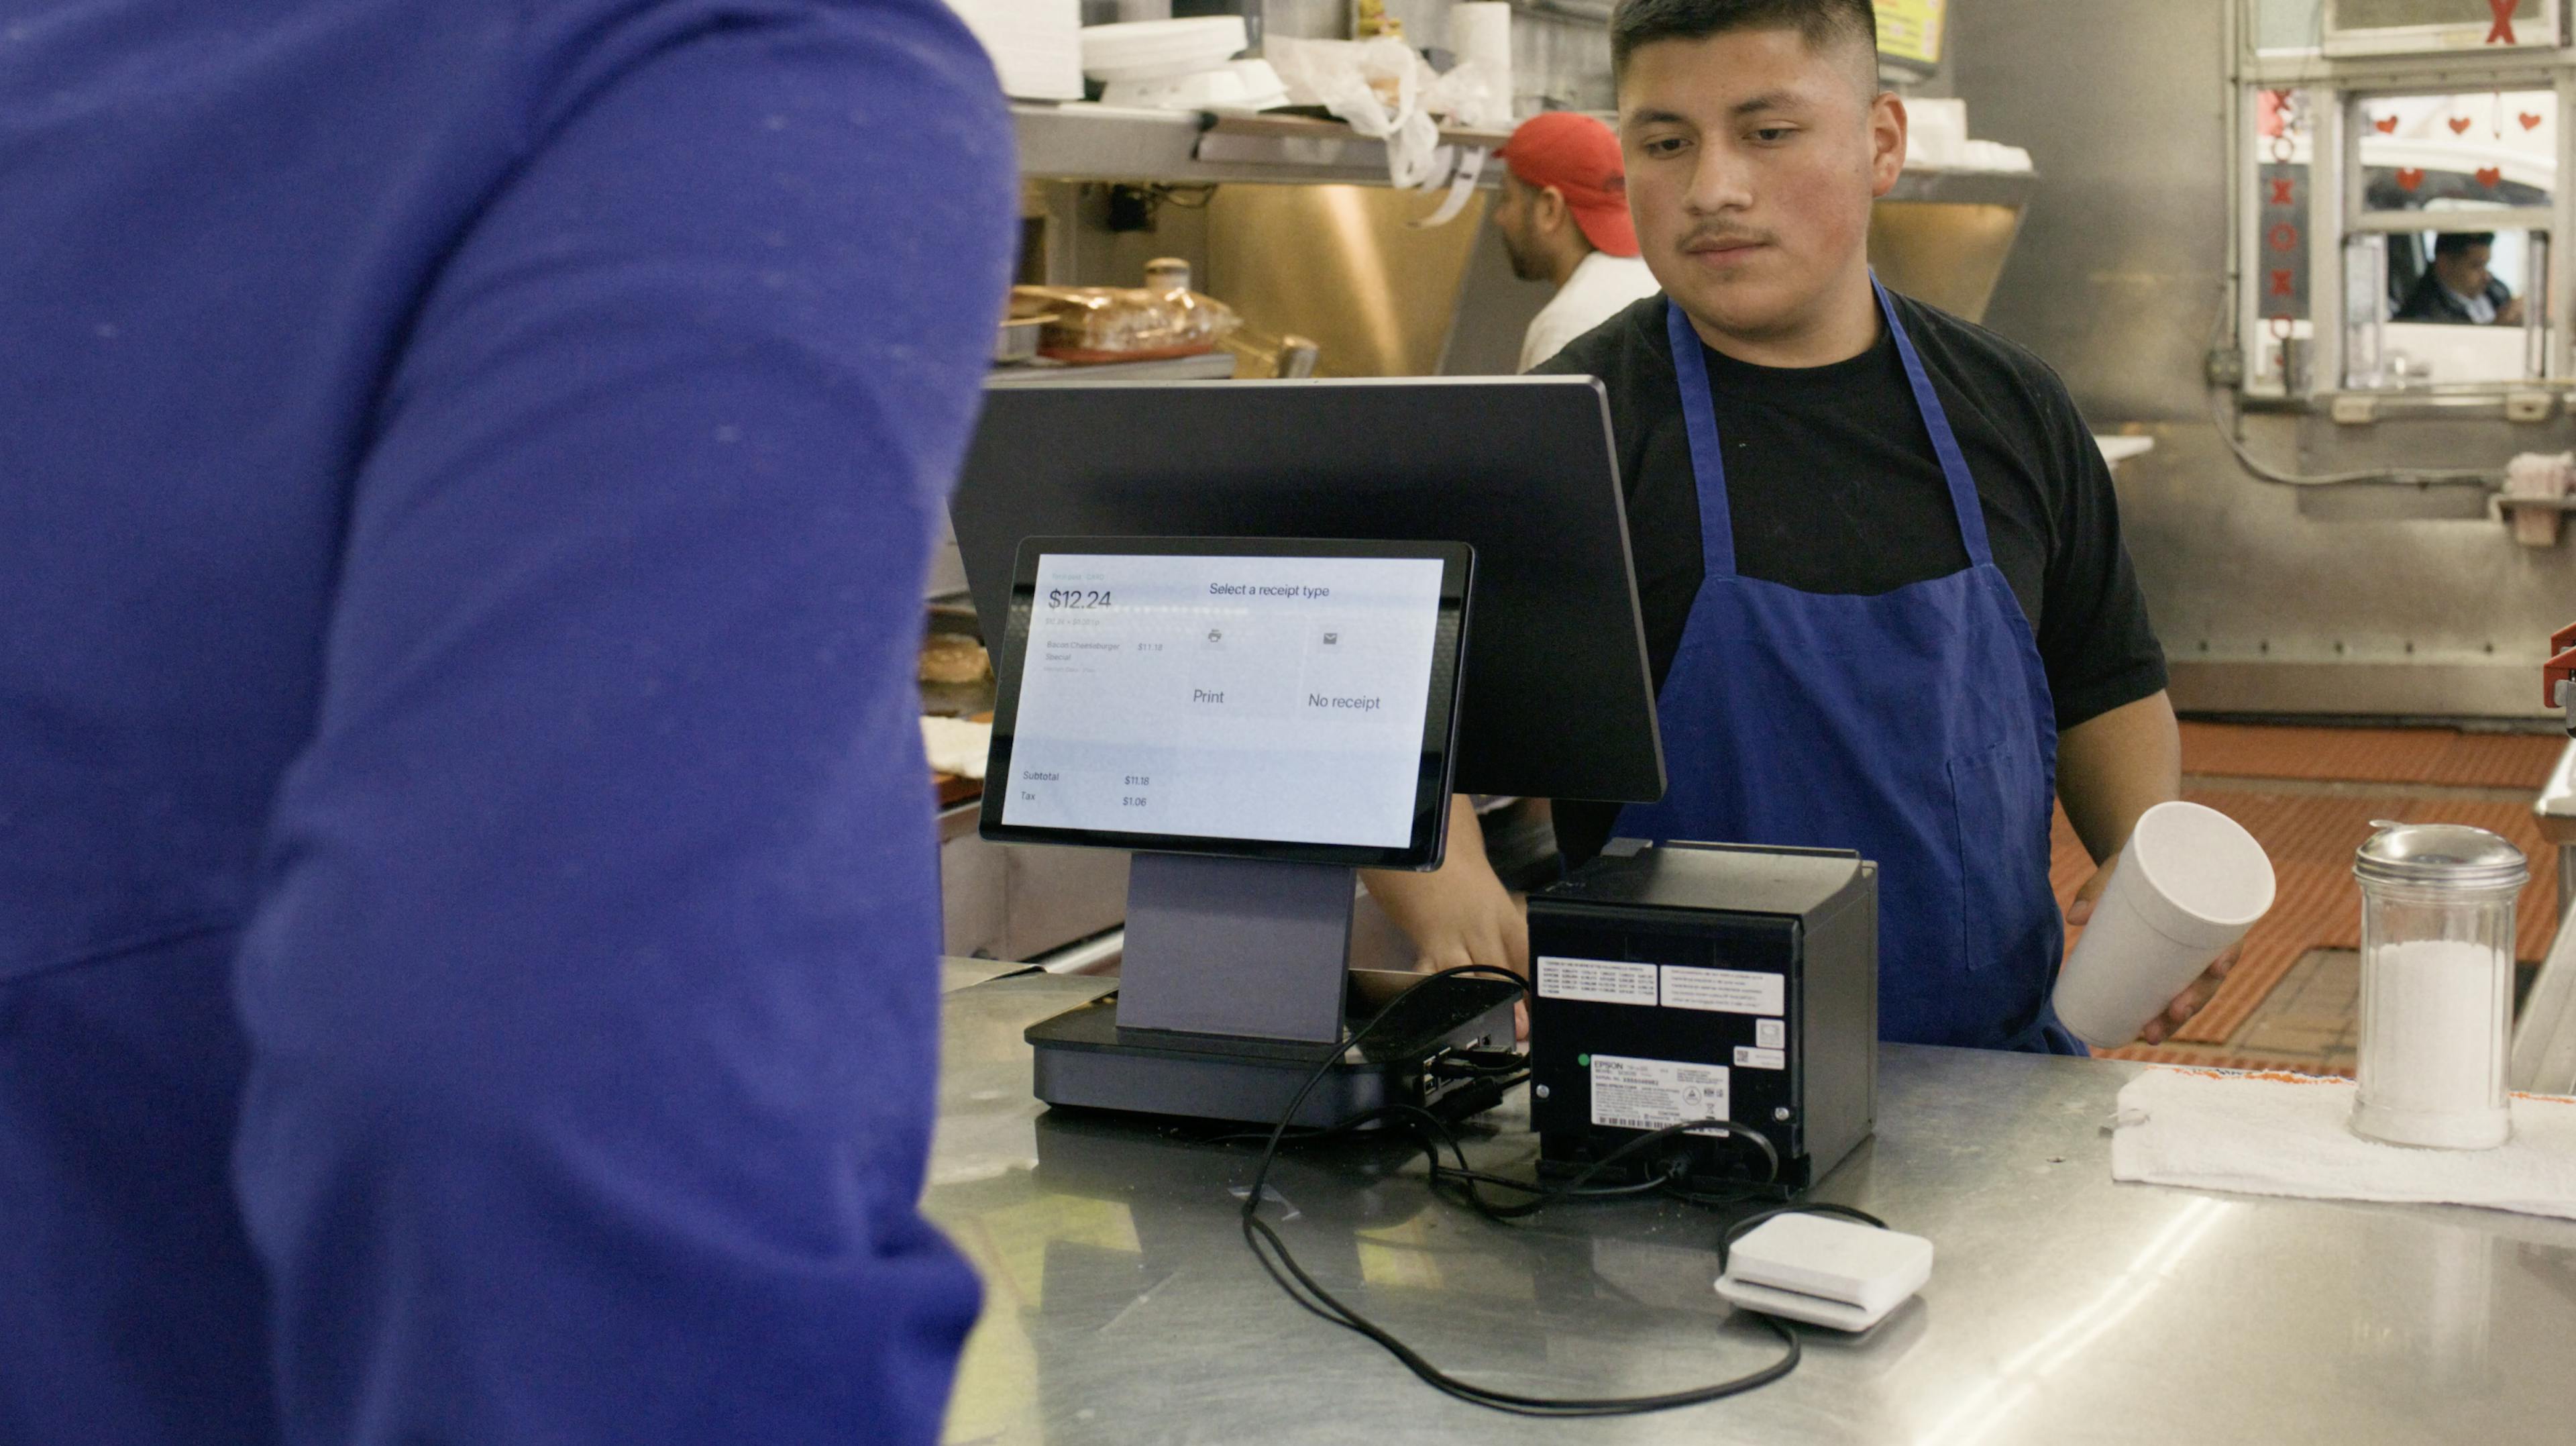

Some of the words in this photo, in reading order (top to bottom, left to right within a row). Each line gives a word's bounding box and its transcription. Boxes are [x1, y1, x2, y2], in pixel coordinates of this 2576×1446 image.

[1209, 582, 1246, 595] Select
[1248, 586, 1256, 595] a
[1259, 584, 1299, 599] receipt
[1303, 585, 1330, 599] type
[1048, 588, 1112, 610] $12.24
[1046, 640, 1069, 649] Bacon
[1070, 641, 1120, 652] Cheeseburger
[1138, 643, 1163, 652] $11.18
[1045, 653, 1071, 661] Special
[1193, 688, 1225, 704] Print
[1308, 693, 1328, 708] No
[1332, 695, 1381, 712] receipt
[1023, 771, 1059, 781] Subtotal
[1124, 776, 1150, 786] $11.18
[1021, 790, 1036, 801] Tax
[1122, 796, 1147, 807] $1.06
[1594, 1060, 1623, 1070] EPSON
